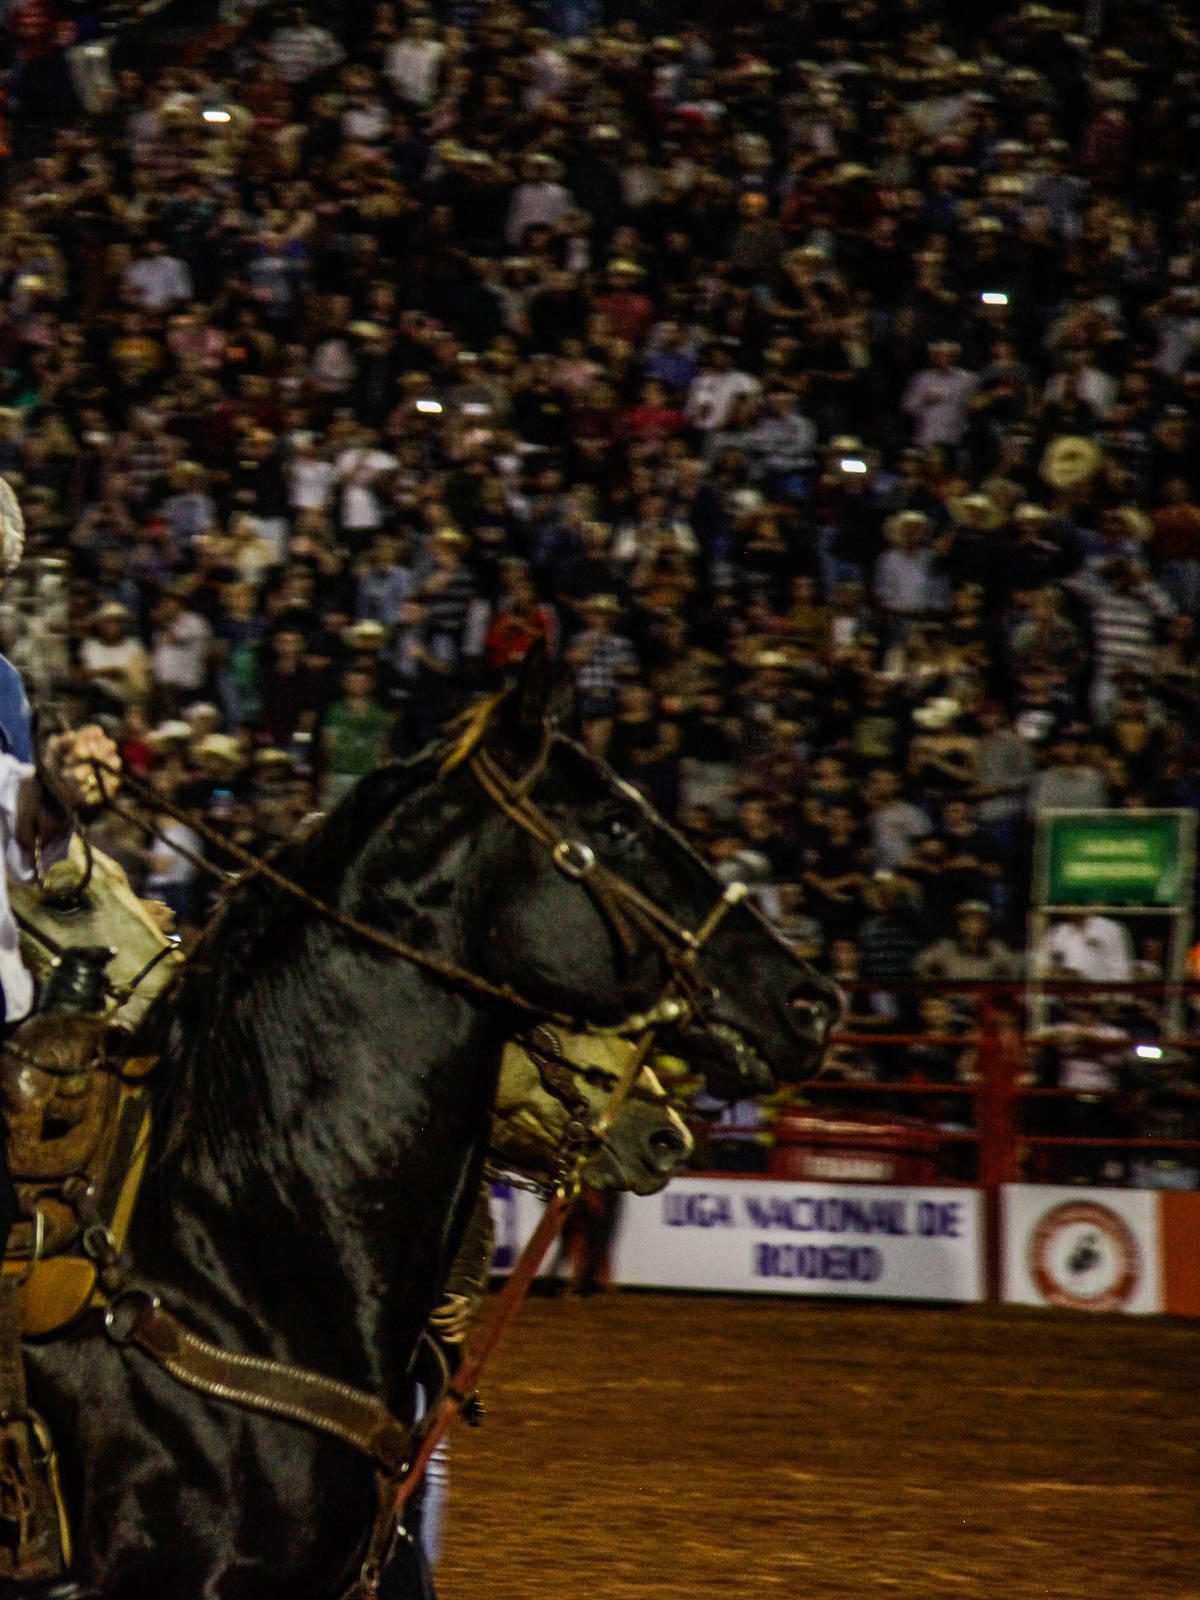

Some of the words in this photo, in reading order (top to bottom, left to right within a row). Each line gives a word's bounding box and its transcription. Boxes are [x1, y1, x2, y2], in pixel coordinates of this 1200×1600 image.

[663, 1193, 734, 1227] LIGA
[745, 1197, 910, 1236] NACIONAL
[916, 1201, 962, 1238] DE
[755, 1243, 884, 1282] RODEO
